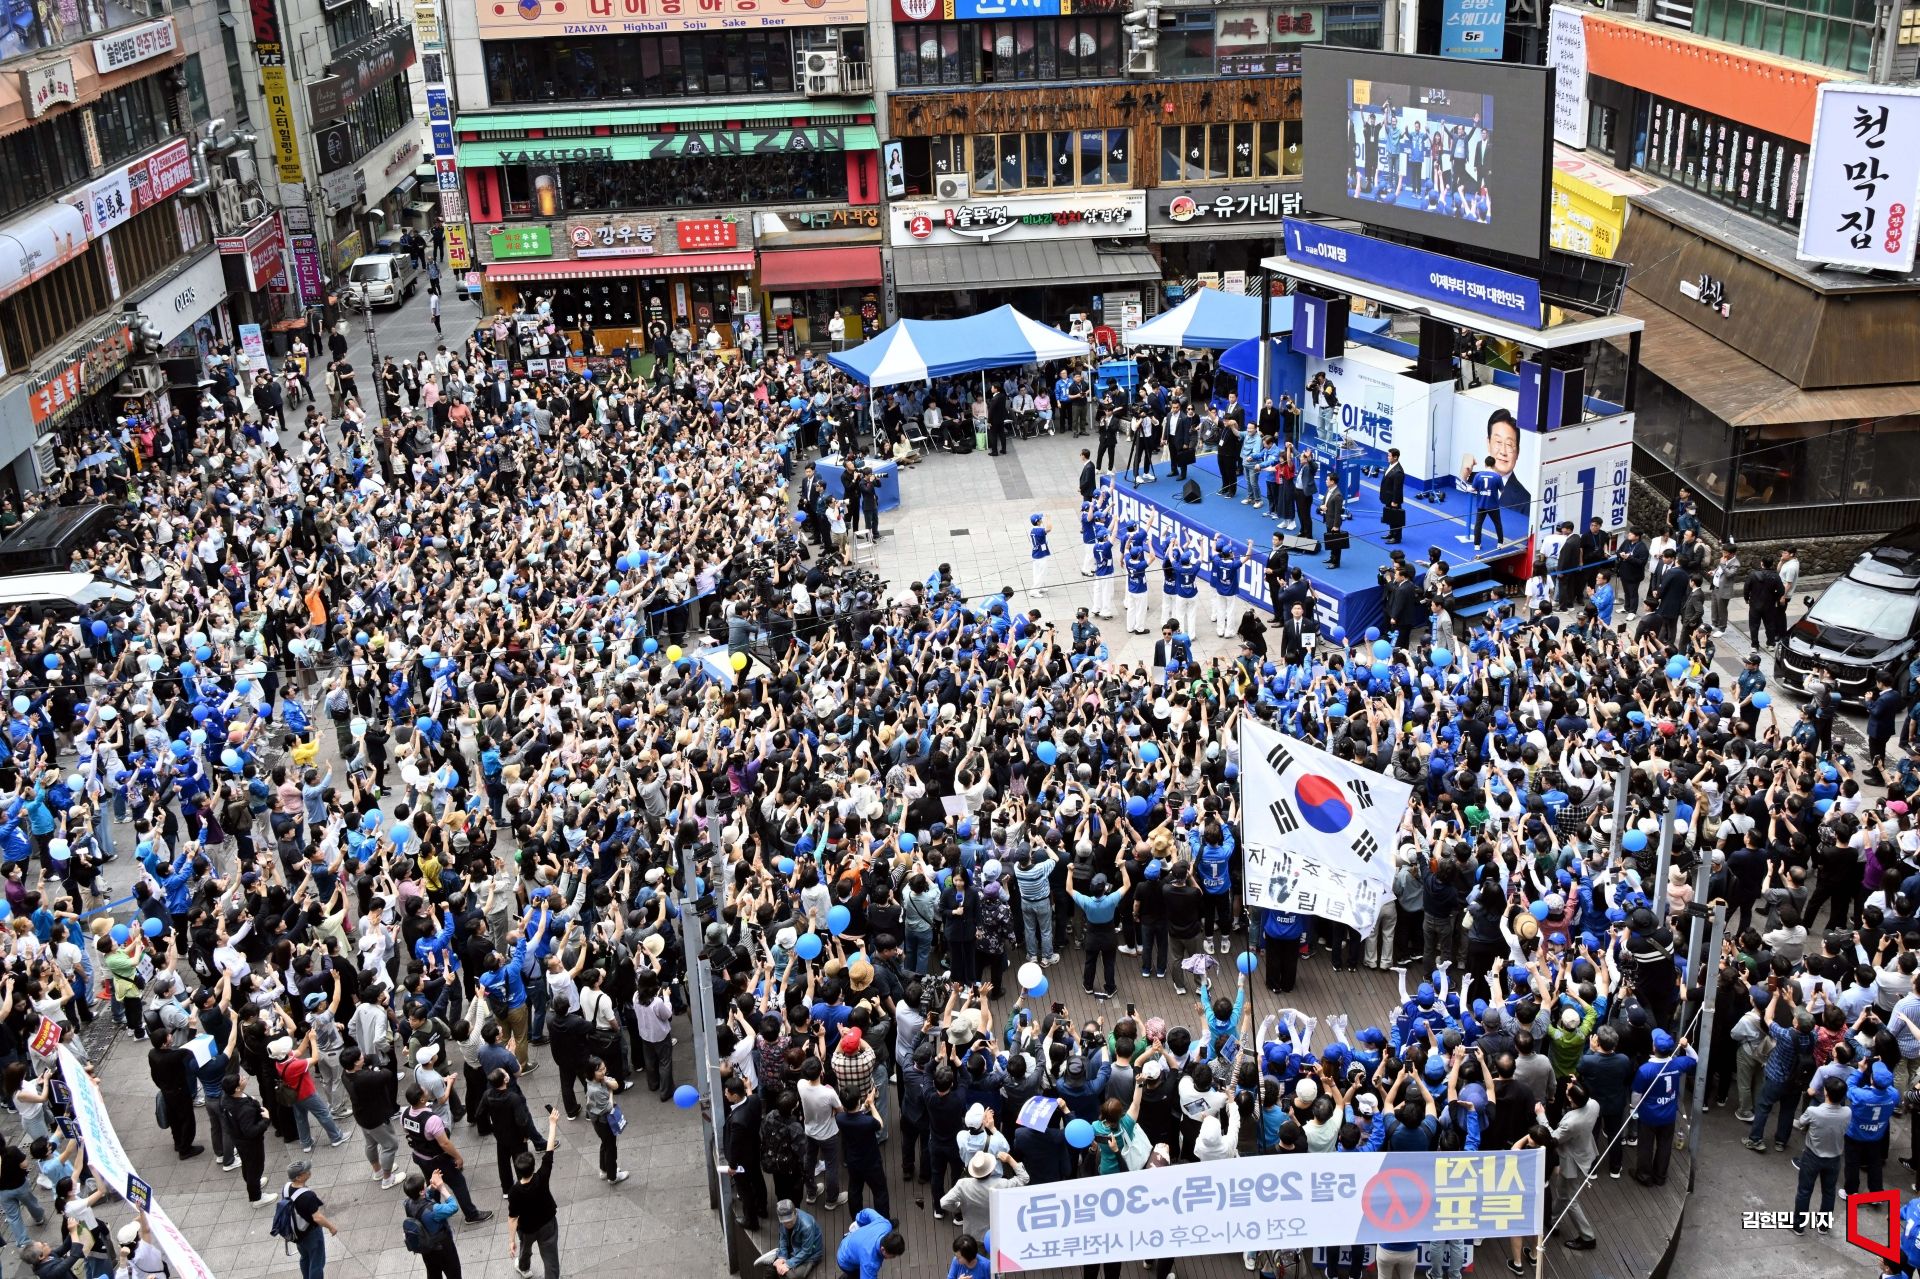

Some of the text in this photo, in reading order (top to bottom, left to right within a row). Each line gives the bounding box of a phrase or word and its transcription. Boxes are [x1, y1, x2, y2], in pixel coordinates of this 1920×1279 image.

[564, 17, 786, 34] IZAKAYA Highball Soju Sake Beer
[1277, 12, 1315, 36] 타로
[1447, 12, 1502, 26] 스웨디시
[1464, 32, 1481, 41] 5F
[260, 55, 281, 64] 7F
[273, 96, 293, 154] 미스터힐링
[648, 127, 845, 158] ZAN ZAN
[499, 147, 614, 165] YAKITORI
[1836, 105, 1889, 250] 천막집
[1213, 192, 1304, 218] 유가네닭
[800, 211, 831, 229] 야구
[833, 209, 878, 228] 사격장
[913, 219, 930, 236] 生
[956, 206, 1128, 227] 솥뚜껑 미나리 김치 삼겹살
[595, 224, 656, 246] 깡우동
[1887, 206, 1903, 251] 포장마차
[449, 232, 465, 261] 노래
[1294, 230, 1347, 263] 1 지금은 이재명
[300, 255, 317, 295] 코인노래
[1430, 272, 1526, 310] 이제부터 진짜 대한민국
[1699, 272, 1723, 311] 한잔
[1304, 303, 1315, 349] 1
[1328, 364, 1344, 377] 민주당
[1342, 404, 1393, 445] 이재명
[1615, 459, 1628, 468] 지금은
[1544, 477, 1558, 485] 지금은
[1577, 467, 1596, 535] 1
[1611, 468, 1628, 526] 이재명
[1210, 863, 1219, 878] 1
[1664, 1075, 1673, 1092] 1
[1871, 1105, 1881, 1121] 1
[1904, 1218, 1914, 1237] 1
